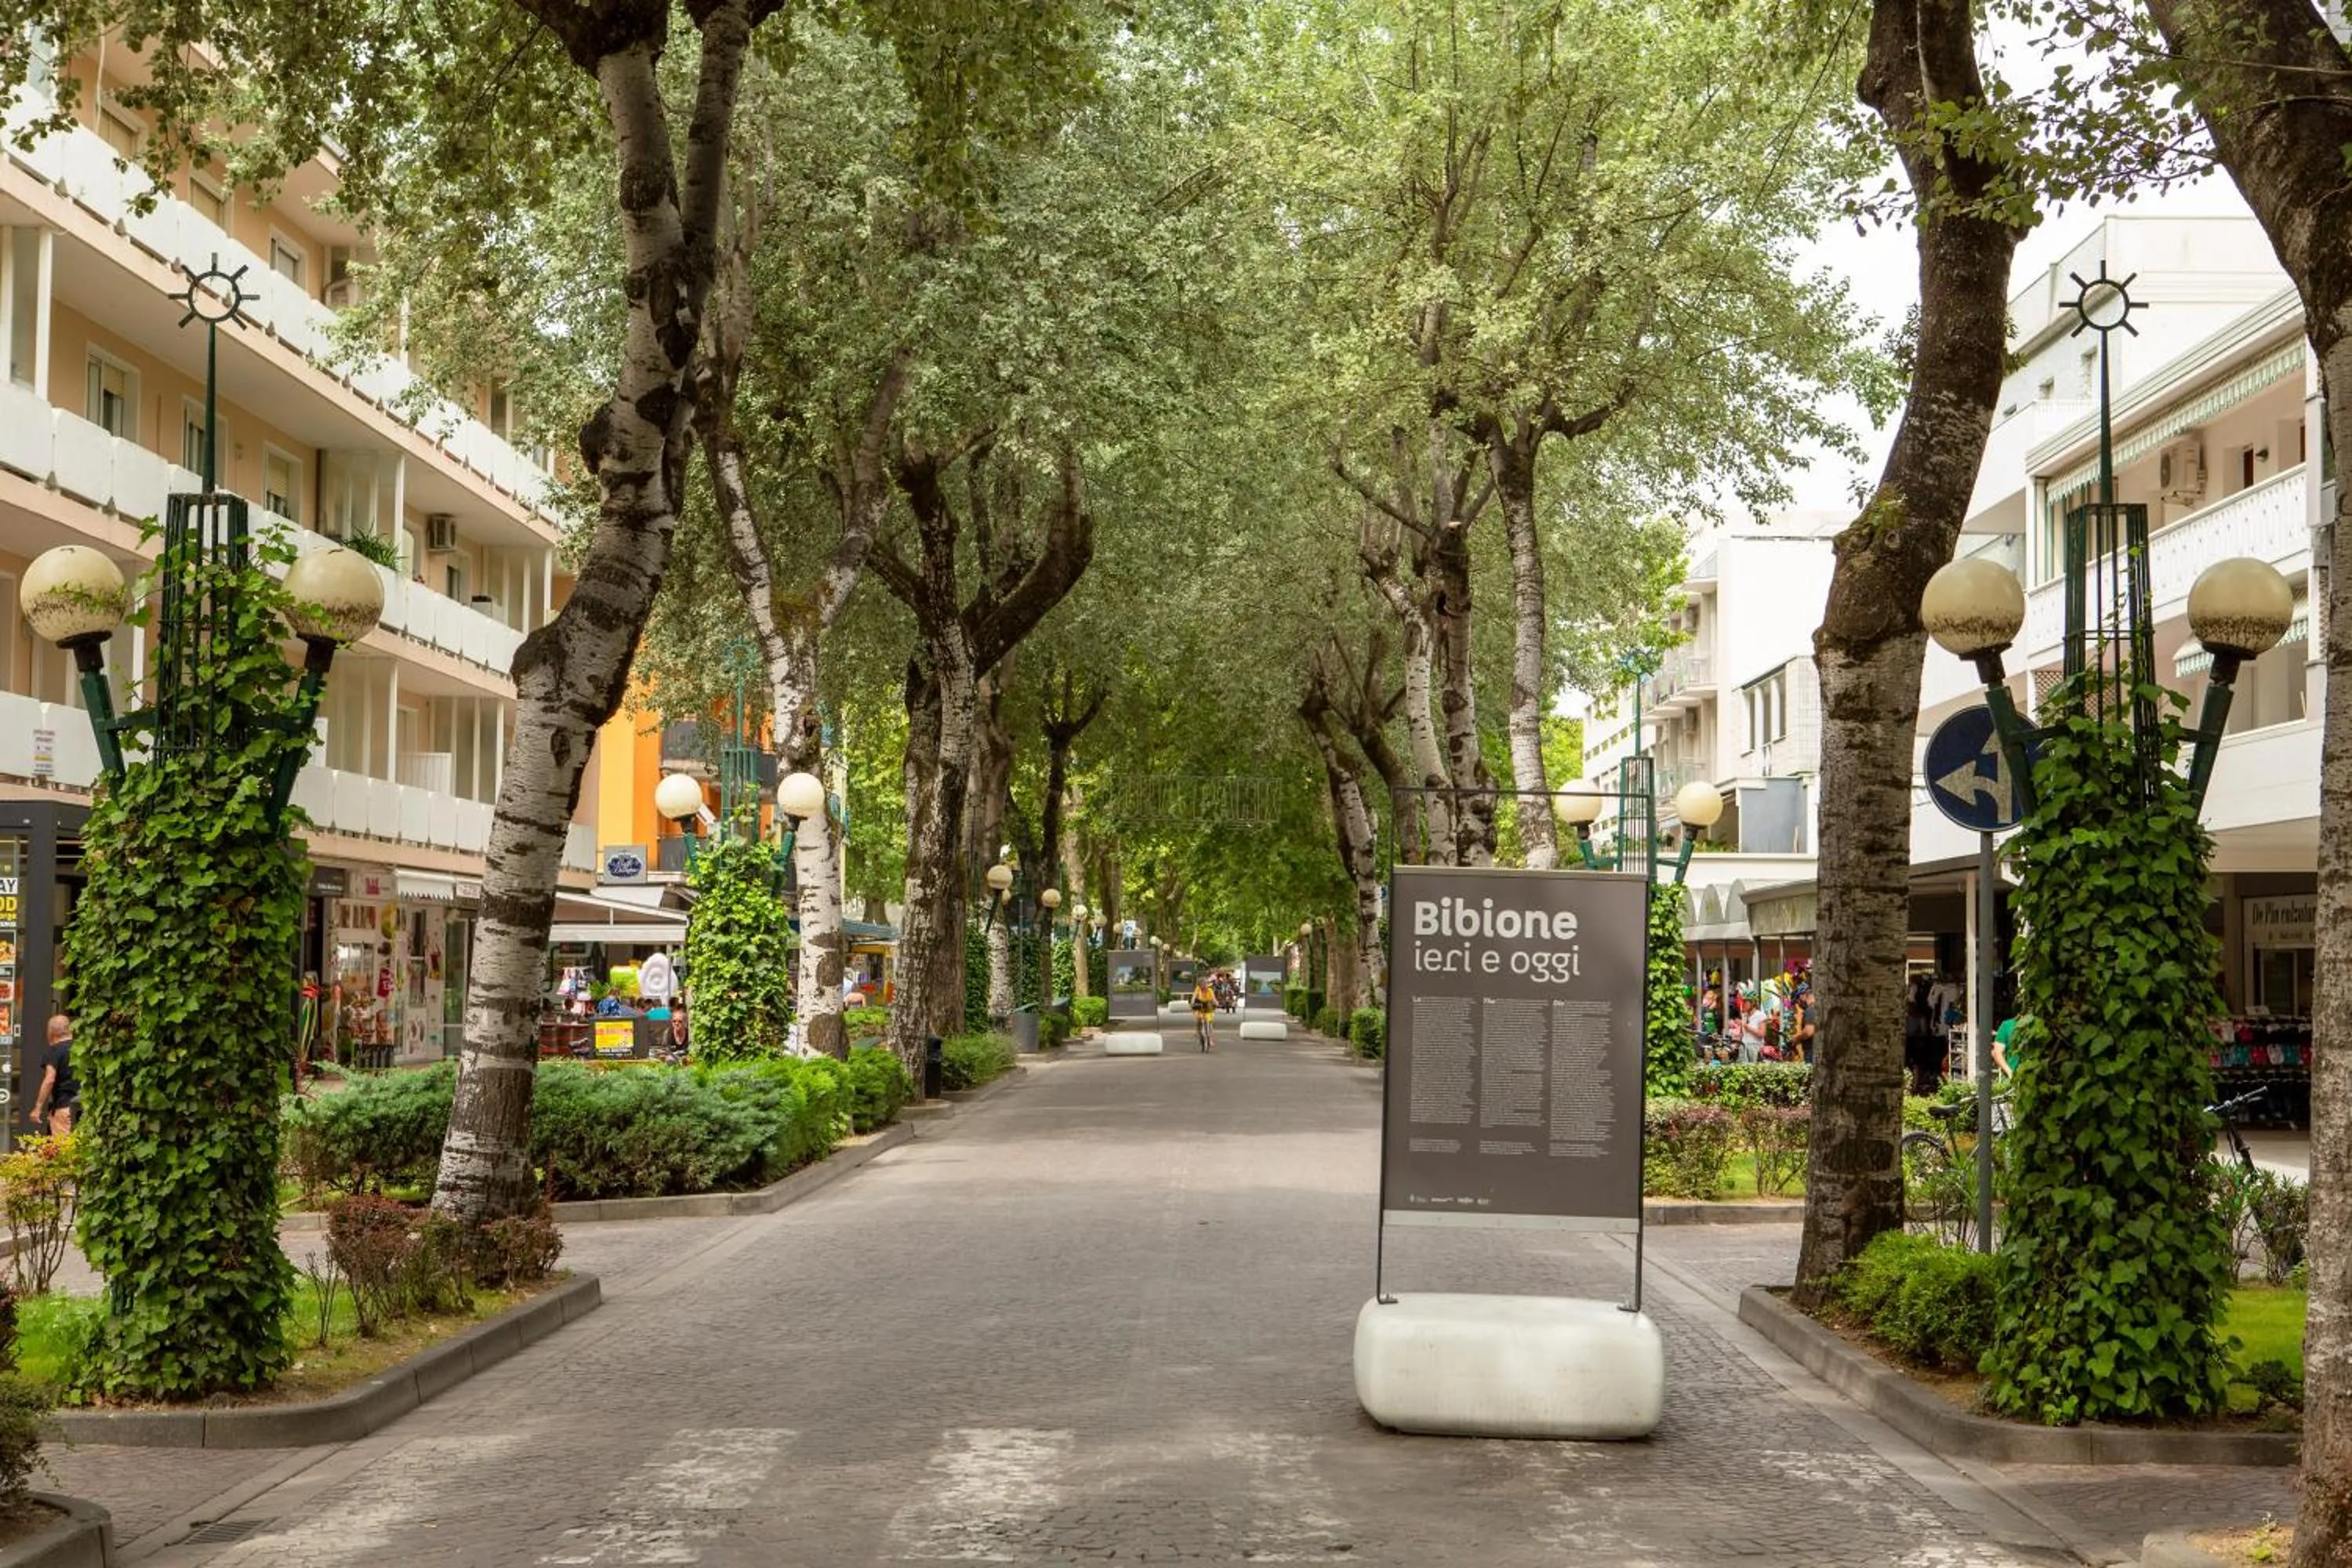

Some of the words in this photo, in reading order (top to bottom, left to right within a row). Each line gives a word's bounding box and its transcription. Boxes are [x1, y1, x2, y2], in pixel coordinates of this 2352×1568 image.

[1414, 896, 1578, 940] Bibione
[1414, 940, 1472, 973] ieri
[1480, 949, 1501, 974] e
[1510, 945, 1581, 983] oggi
